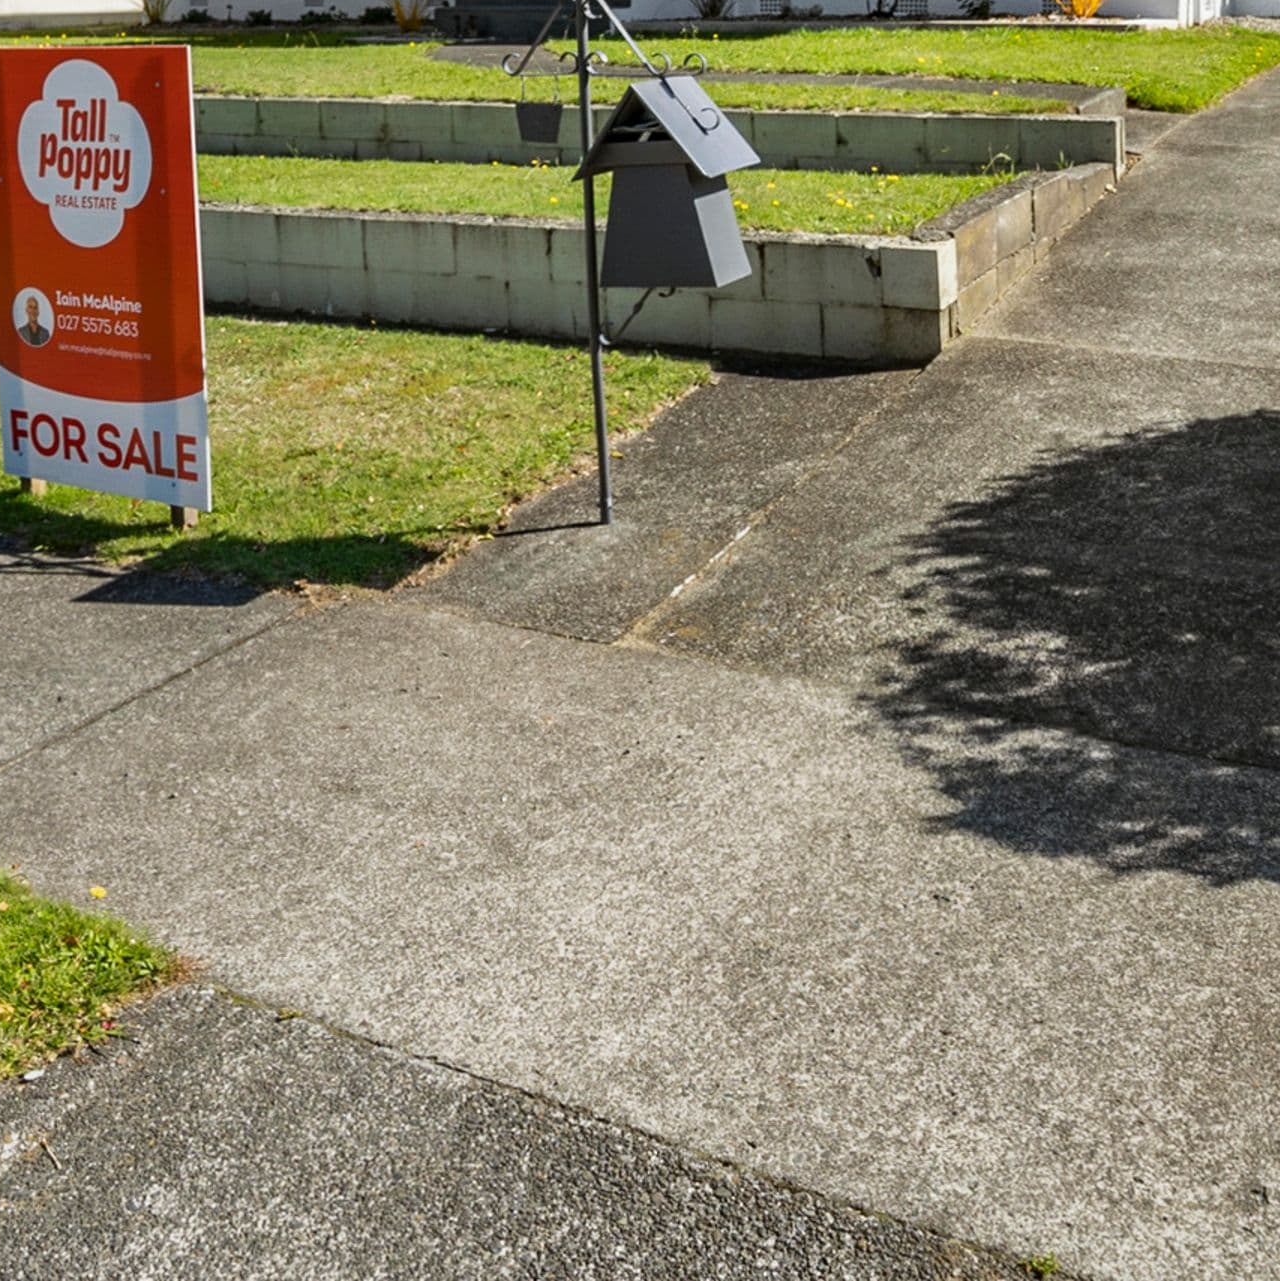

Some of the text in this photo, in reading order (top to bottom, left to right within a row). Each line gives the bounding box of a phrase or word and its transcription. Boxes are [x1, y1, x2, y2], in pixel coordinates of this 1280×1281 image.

[56, 98, 106, 142] Tall
[39, 133, 131, 193] poppy
[55, 194, 117, 210] REAL ESTATE
[56, 290, 142, 315] Iain McAlpine
[57, 314, 139, 338] 027 5575 683
[10, 409, 198, 481] FOR SALE
